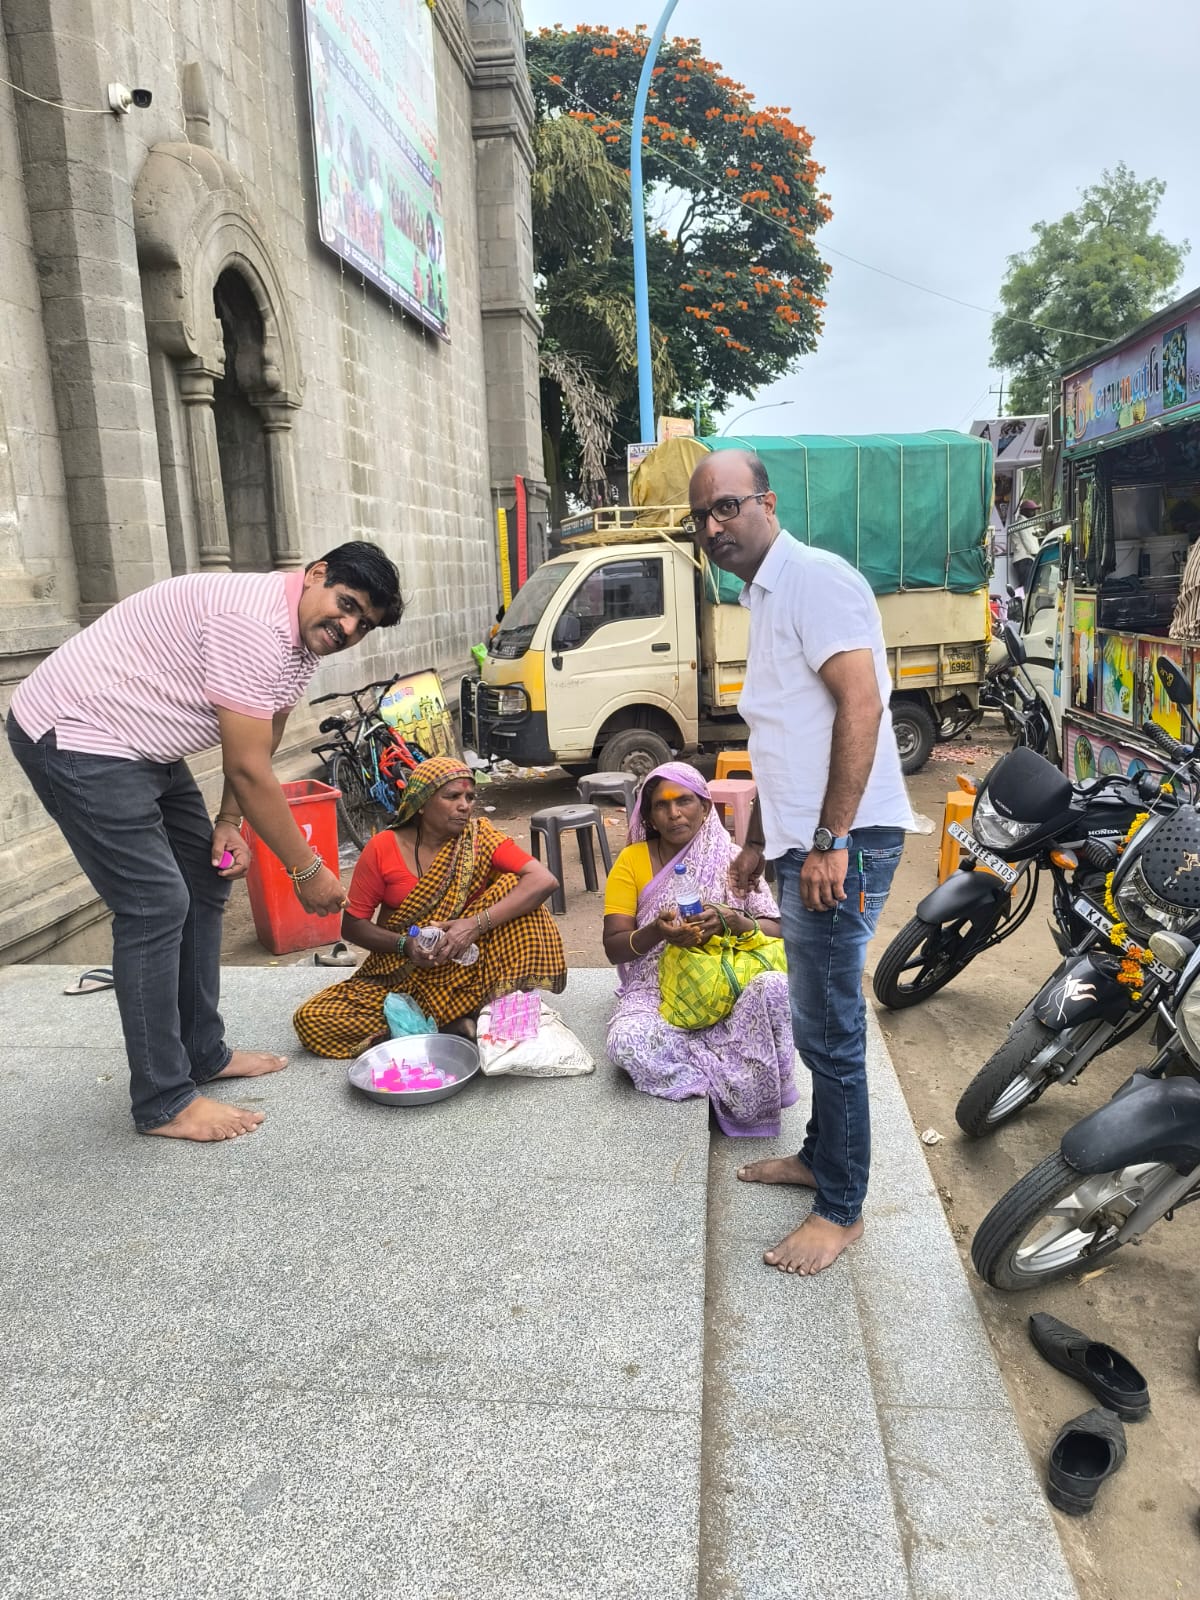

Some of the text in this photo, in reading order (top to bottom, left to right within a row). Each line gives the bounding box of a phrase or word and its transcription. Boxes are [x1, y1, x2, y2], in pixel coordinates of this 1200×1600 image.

[951, 662, 971, 671] 6982
[1088, 828, 1120, 836] HONDA
[990, 859, 1014, 881] 2105
[1086, 907, 1104, 928] KA
